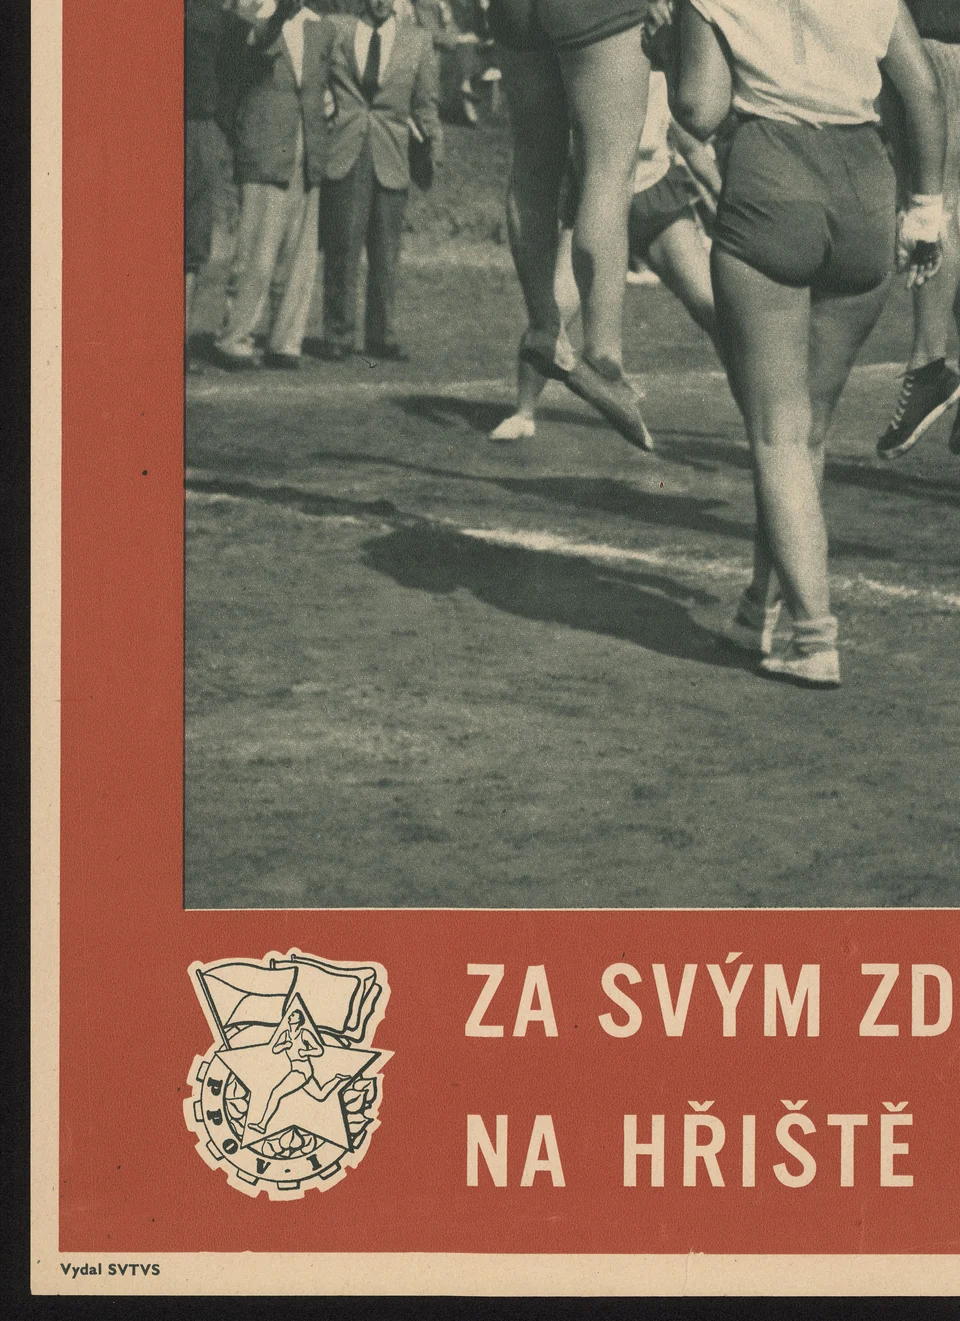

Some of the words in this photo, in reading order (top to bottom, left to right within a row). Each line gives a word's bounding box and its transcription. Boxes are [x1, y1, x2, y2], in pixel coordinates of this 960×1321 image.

[464, 963, 559, 1038] ZA
[598, 951, 821, 1038] SVÝM
[466, 1114, 566, 1188] NA
[623, 1099, 914, 1188] HŘIŠTĚ
[60, 1263, 102, 1279] Vydal
[108, 1263, 161, 1276] SVTVS
